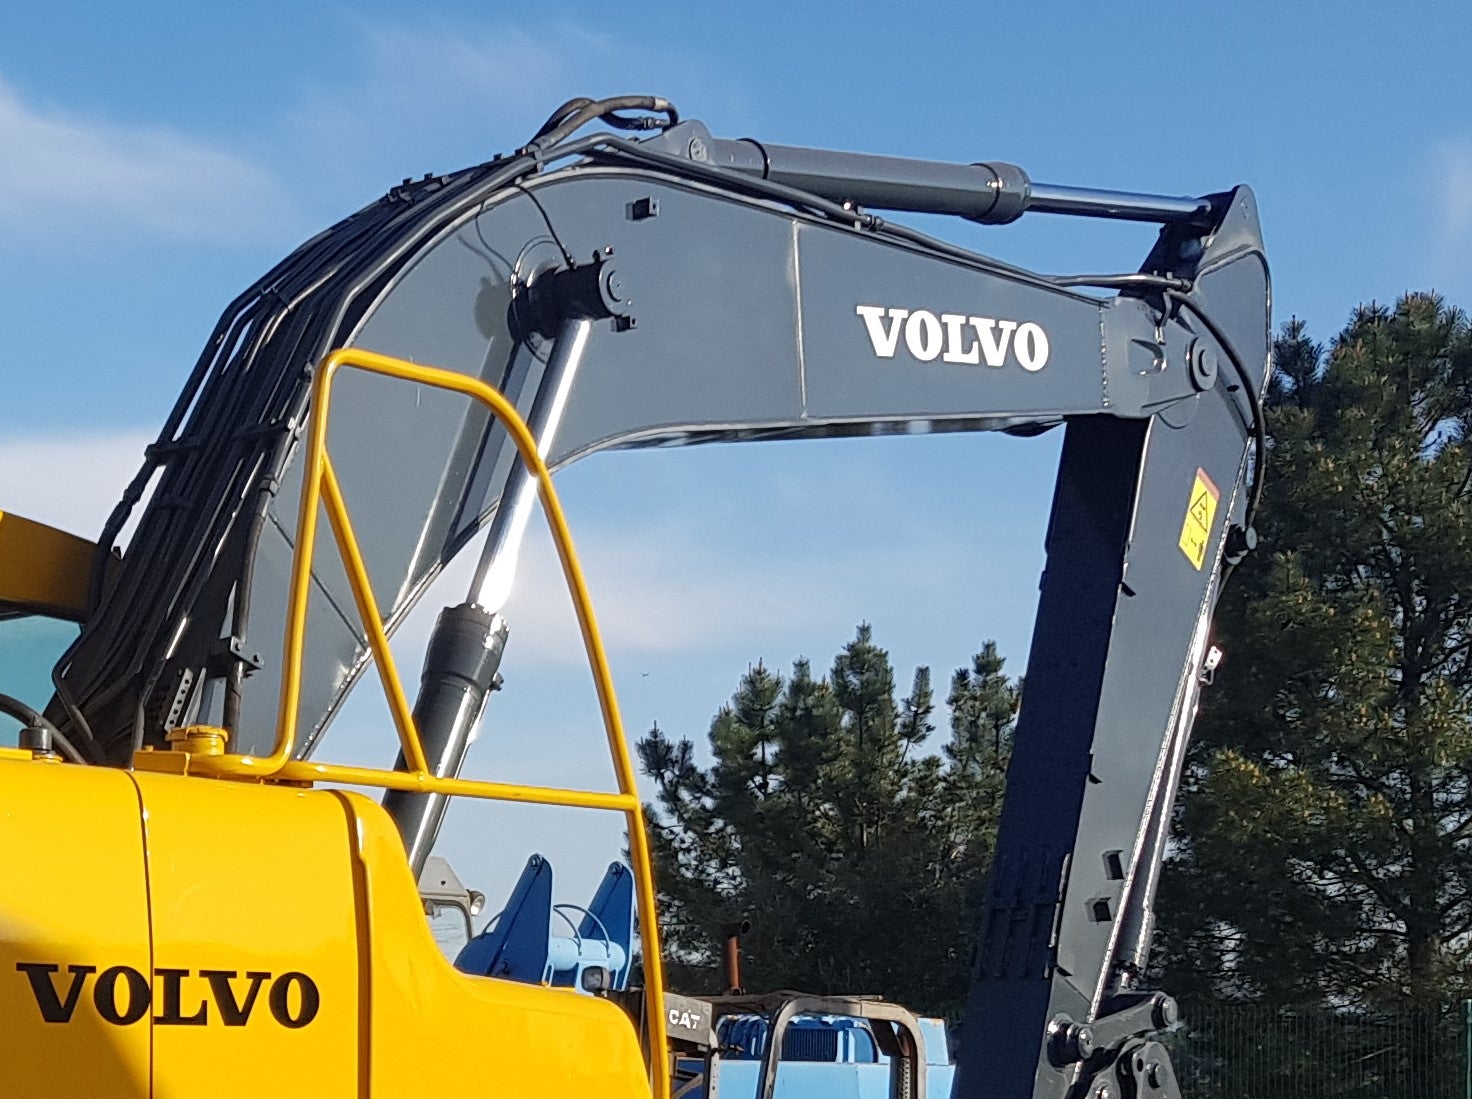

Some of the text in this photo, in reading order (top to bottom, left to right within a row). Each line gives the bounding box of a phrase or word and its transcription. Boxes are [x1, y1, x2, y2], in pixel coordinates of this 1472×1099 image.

[856, 304, 1049, 372] VOLVO
[16, 962, 320, 1029] VOLVO
[668, 1008, 701, 1030] CAT
